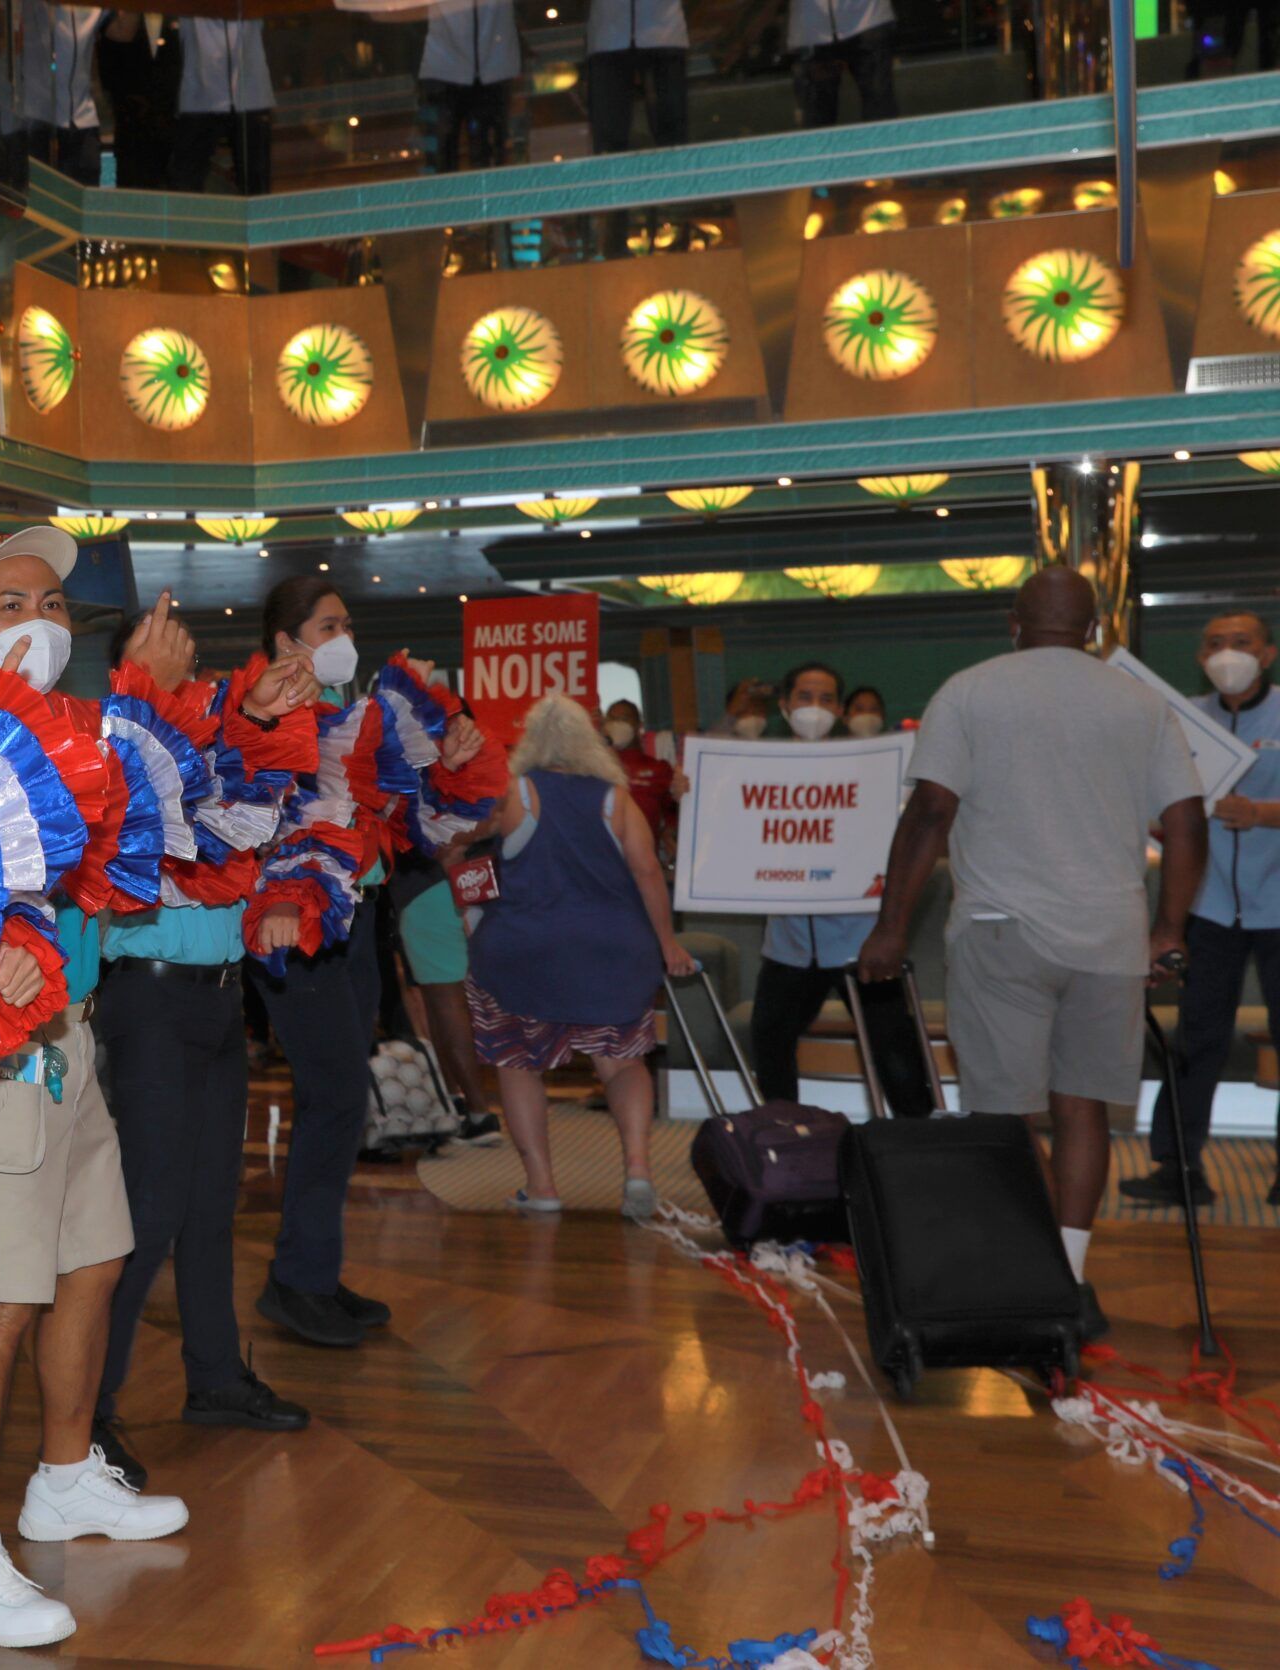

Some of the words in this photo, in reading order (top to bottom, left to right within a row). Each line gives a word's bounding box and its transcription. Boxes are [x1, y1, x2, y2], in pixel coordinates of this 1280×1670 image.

[474, 623, 528, 649] MAKE
[532, 619, 588, 646] SOME
[472, 650, 588, 701] NOISE
[741, 782, 859, 811] WELCOME
[762, 817, 835, 845] HOME
[755, 868, 805, 882] #CHOOSE
